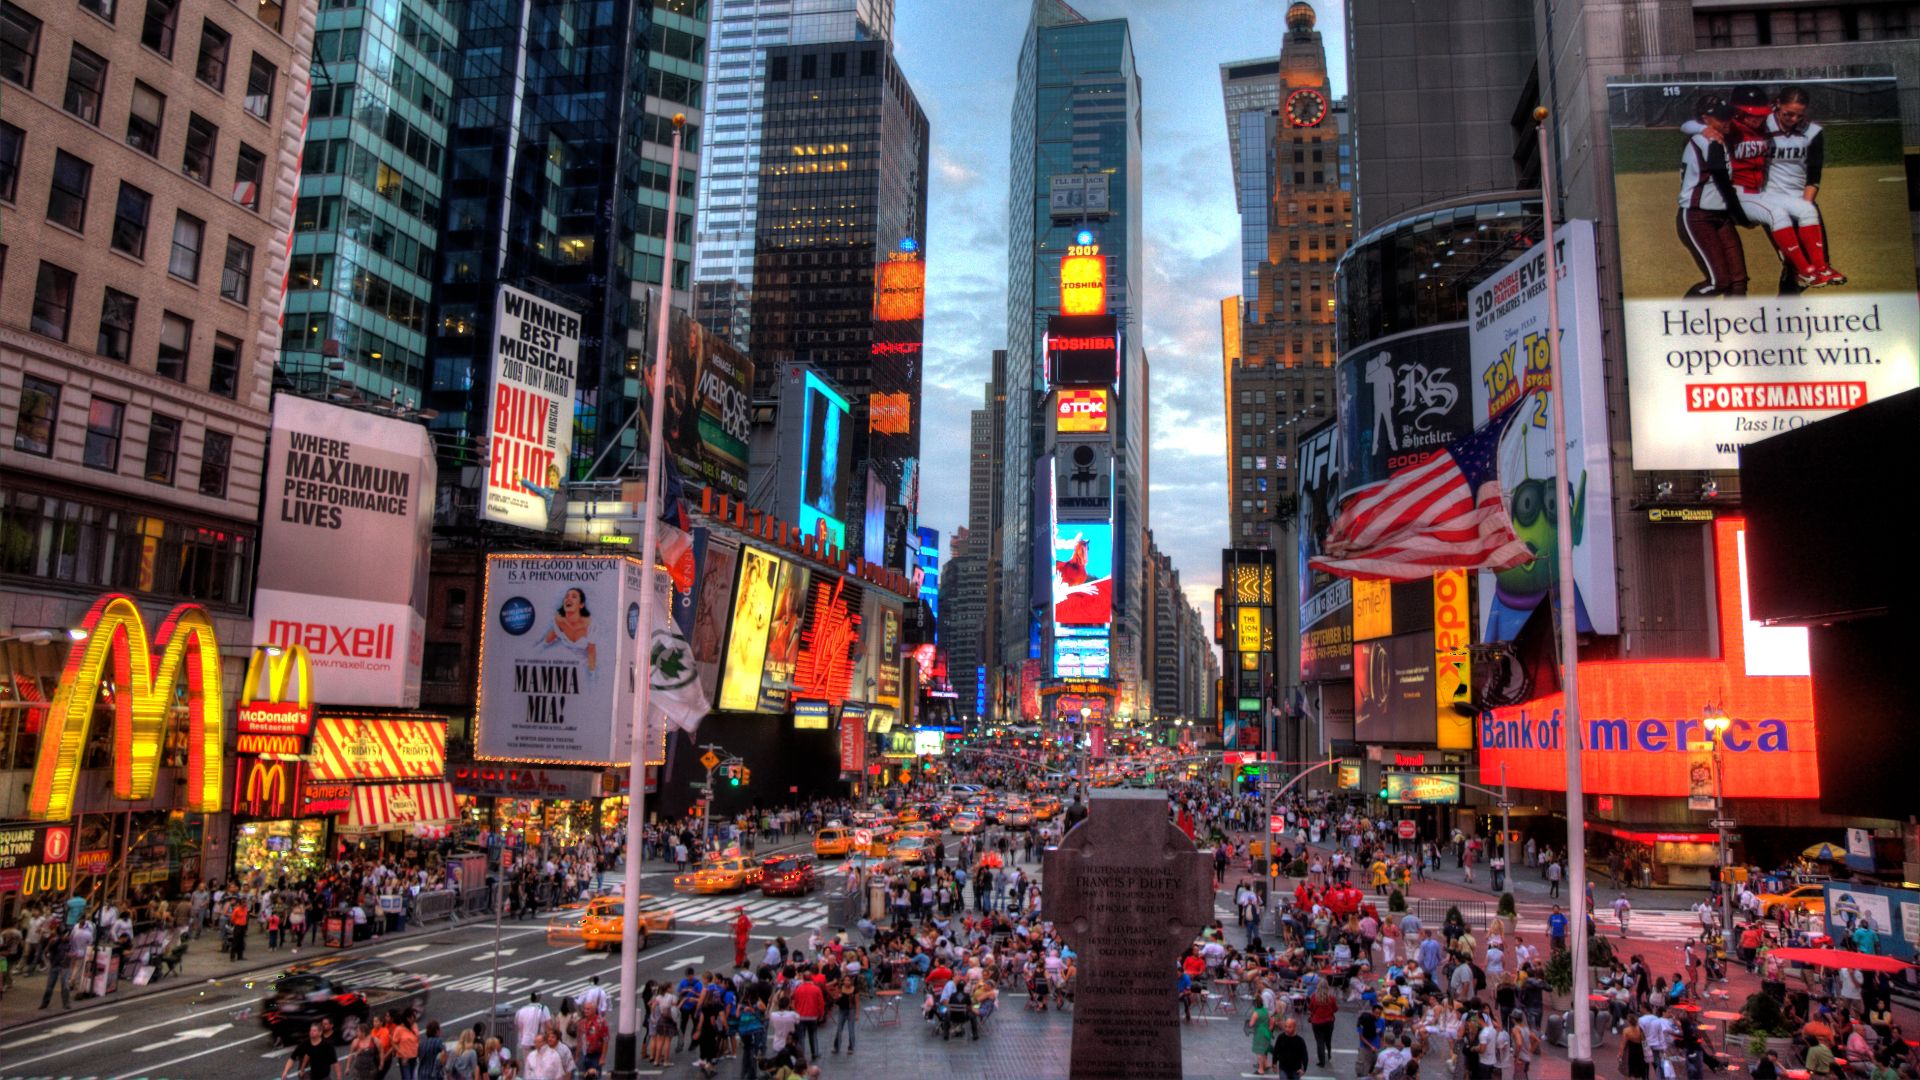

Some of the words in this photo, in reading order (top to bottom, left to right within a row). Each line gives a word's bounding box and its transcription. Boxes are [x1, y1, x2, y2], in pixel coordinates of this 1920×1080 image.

[1769, 146, 1808, 160] ENTRA
[1068, 246, 1099, 256] 2009
[1493, 270, 1519, 295] DOUBLE
[1494, 282, 1519, 306] FEATURE
[504, 290, 579, 340] WINNER
[1475, 290, 1493, 318] 3D
[1475, 317, 1489, 332] ONLY
[1489, 313, 1496, 324] IN
[1496, 295, 1520, 320] THEATRES
[520, 321, 561, 353] BEST
[1521, 316, 1536, 330] PIXAR
[1662, 307, 1768, 342] Helped
[1776, 304, 1882, 340] injured
[500, 335, 575, 379] MUSICAL
[1048, 337, 1115, 350] TOSHIBA
[1666, 345, 1808, 375] opponent
[1814, 339, 1881, 365] win.
[503, 358, 523, 382] 2009
[525, 366, 542, 389] TONY
[544, 373, 568, 398] AWARD
[1483, 340, 1517, 400] TOY
[1525, 373, 1553, 389] STOR
[698, 369, 747, 422] MELROSE
[1070, 402, 1103, 413] TDK
[1397, 362, 1459, 431] RS
[1490, 382, 1517, 417] STORY
[1532, 388, 1548, 430] 2
[1691, 384, 1862, 409] SPORTSMANSHIP
[494, 383, 549, 445] BILLY
[548, 400, 559, 433] MUSICAL
[722, 407, 749, 445] PLACE
[1735, 416, 1767, 432] Pass
[1773, 416, 1784, 431] It
[290, 431, 350, 460] WHERE
[547, 435, 556, 448] THE
[286, 451, 410, 497] MAXIMUM
[490, 439, 555, 497] ELLIOT
[284, 479, 407, 516] PERFORMANCE
[281, 499, 342, 529] LIVES
[509, 571, 517, 580] IS
[521, 571, 526, 580] A
[521, 560, 573, 570] FEEL-GOOD
[576, 560, 618, 570] MUSICAL
[1357, 588, 1386, 617] smile?
[269, 620, 394, 660] maxell
[1241, 624, 1258, 634] LION
[1241, 636, 1258, 645] KING
[1311, 626, 1341, 646] SEPTEMBER
[1343, 625, 1351, 641] 19
[513, 665, 580, 694] MAMMA
[240, 711, 307, 724] McDonald's
[526, 695, 566, 724] MIA!
[250, 723, 295, 731] Restaurant
[1481, 710, 1533, 750] Bank
[1537, 708, 1561, 750] of
[1387, 766, 1461, 774] MARQUIS
[1411, 777, 1441, 786] WHITE
[0, 829, 35, 844] SQUARE
[1076, 877, 1125, 888] FRANCIS
[1141, 878, 1182, 889] DUFFY
